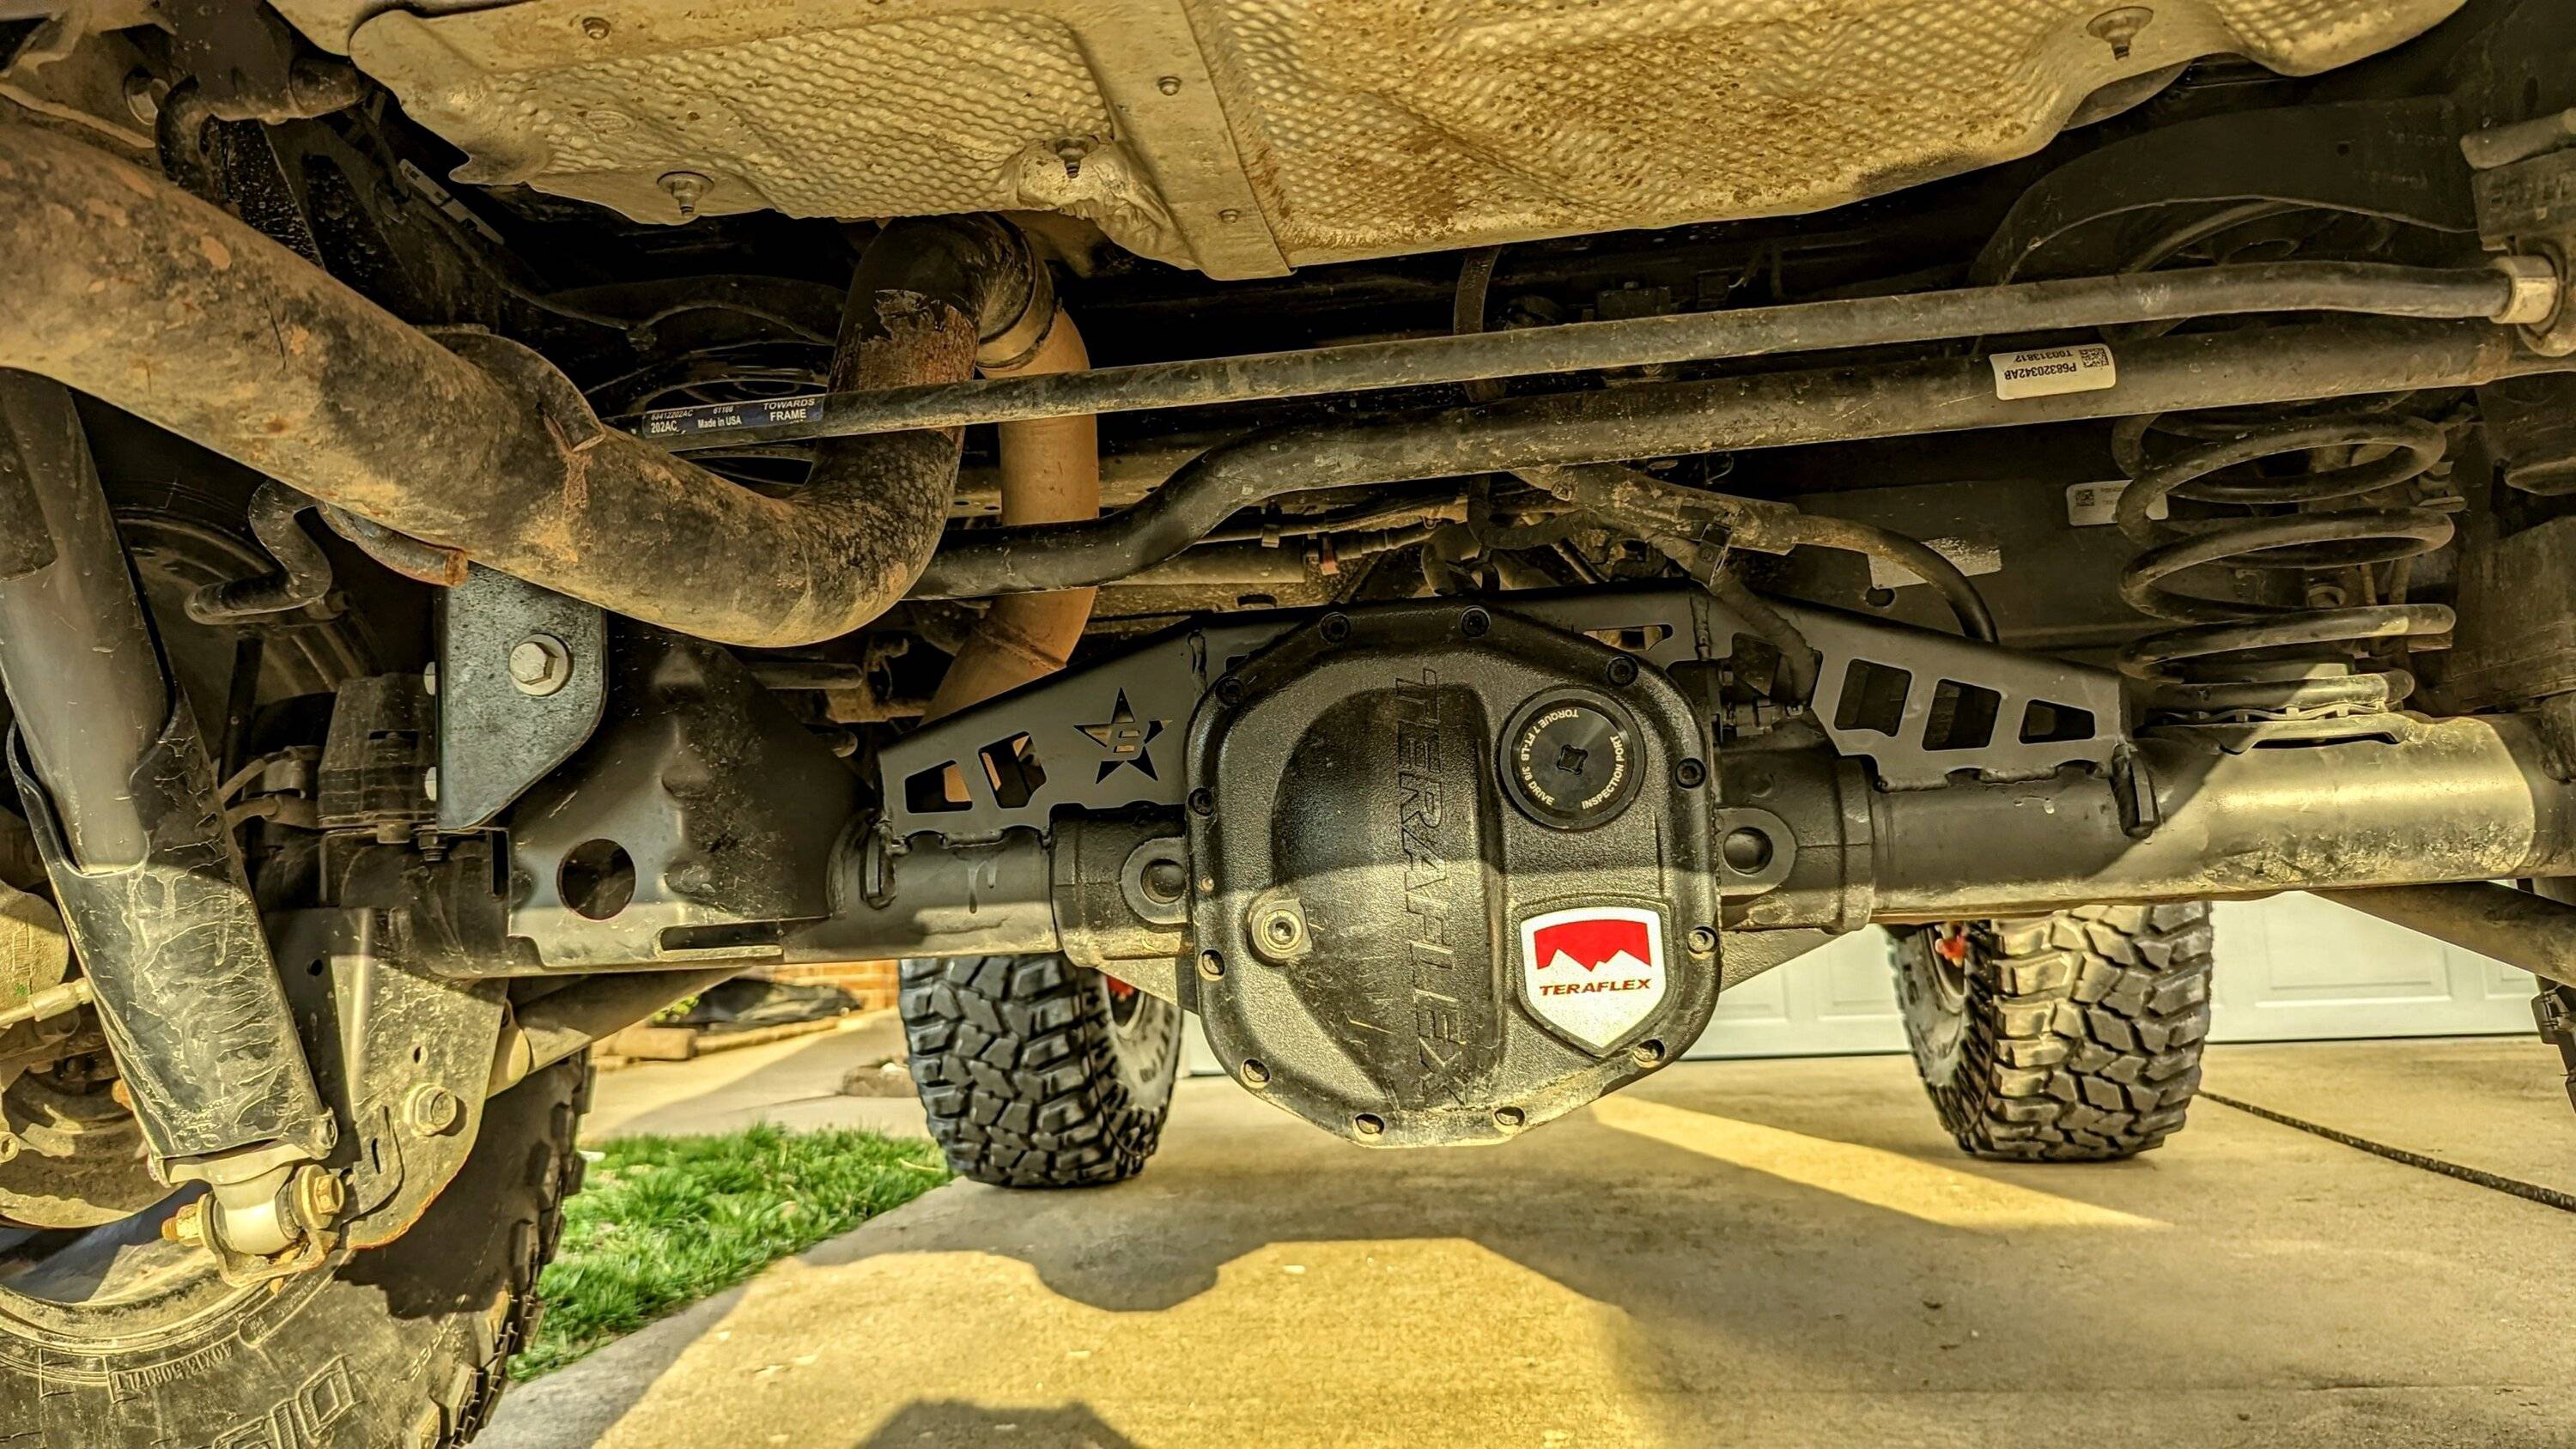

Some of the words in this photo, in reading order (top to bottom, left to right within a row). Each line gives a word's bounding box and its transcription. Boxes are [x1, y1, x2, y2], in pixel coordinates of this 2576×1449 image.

[2004, 362, 2077, 380] P68320342AB
[763, 397, 815, 410] TOWARDS
[697, 418, 716, 429] Made
[718, 416, 725, 427] in
[726, 415, 742, 426] USA
[769, 409, 806, 421] FRAME
[651, 420, 677, 433] 202AC
[1538, 708, 1579, 729] TORQUE
[1532, 725, 1541, 735] 7
[1582, 764, 1625, 809] INSPECTION
[1610, 735, 1625, 761] PORT
[1522, 766, 1534, 781] 3/8
[1528, 781, 1555, 806] DRIVE
[1396, 668, 1470, 1106] TERAFLEX
[1539, 979, 1651, 996] TERAFLEX
